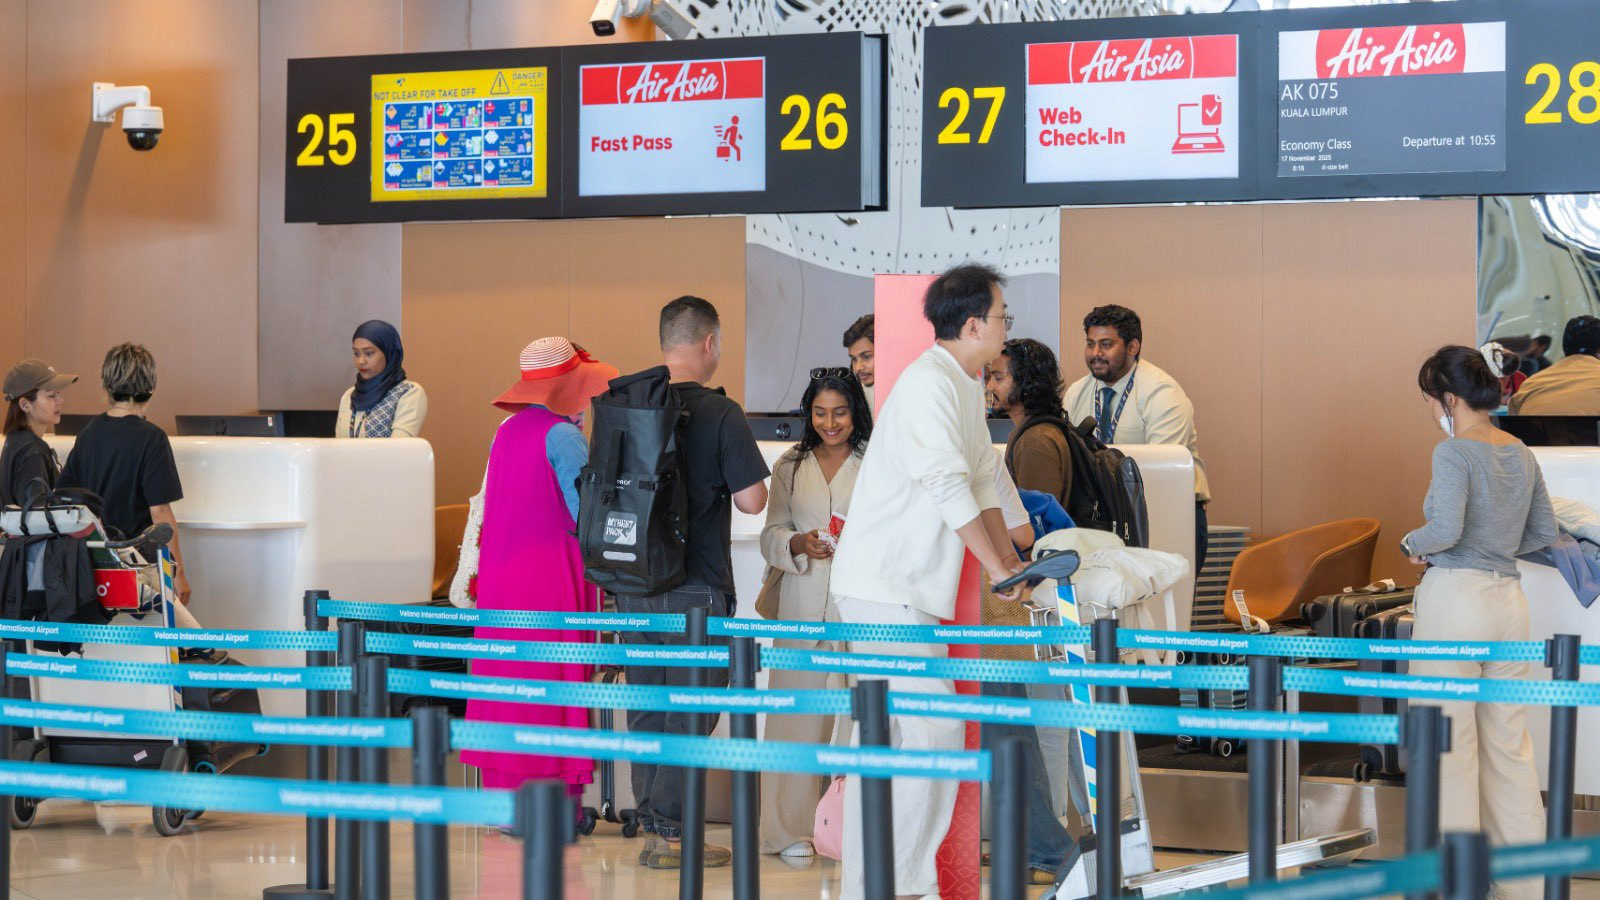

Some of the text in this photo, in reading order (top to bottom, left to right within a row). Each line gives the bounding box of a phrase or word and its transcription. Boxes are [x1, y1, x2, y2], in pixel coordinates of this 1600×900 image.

[512, 72, 543, 80] DANGER!
[374, 88, 477, 100] NOT CLEAR FOR TAKE OFF
[1281, 83, 1338, 100] AK 075
[1524, 61, 1600, 124] 28
[937, 86, 1005, 144] 27
[1039, 106, 1082, 125] Web
[1281, 106, 1348, 118] KUALA LUMPUR
[780, 93, 848, 150] 26
[296, 113, 357, 166] 25
[591, 134, 673, 152] Fast Pass
[1039, 127, 1126, 146] Check-In
[1403, 135, 1496, 149] Departure at 10:55
[1281, 138, 1352, 152] Economy Class
[421, 611, 458, 619] International
[459, 613, 480, 621] Airport
[588, 617, 628, 625] International
[628, 618, 649, 627] Airport
[36, 626, 59, 634] Airport
[723, 621, 826, 634] Velana International Airport
[962, 629, 1013, 637] International
[1014, 629, 1042, 639] Airport
[154, 631, 249, 643] Velana International Airport
[1135, 634, 1248, 649] Velana International Airport
[413, 640, 516, 654] Velana International Airport
[1369, 644, 1490, 656] Velana International Airport
[626, 650, 654, 658] Velana
[656, 651, 707, 659] International
[50, 663, 76, 673] Airport
[811, 655, 926, 671] Velana International Airport
[188, 672, 301, 684] Velana International Airport
[1049, 667, 1172, 681] Velana International Airport
[430, 680, 546, 698] Velana International Airport
[1343, 677, 1479, 694] Velana International Airport
[669, 694, 795, 708] Velana International Airport
[893, 698, 1031, 718] Velana International Airport
[3, 706, 124, 725] Velana International Airport
[252, 722, 385, 738] Velana International Airport
[1178, 716, 1329, 734] Velana International Airport
